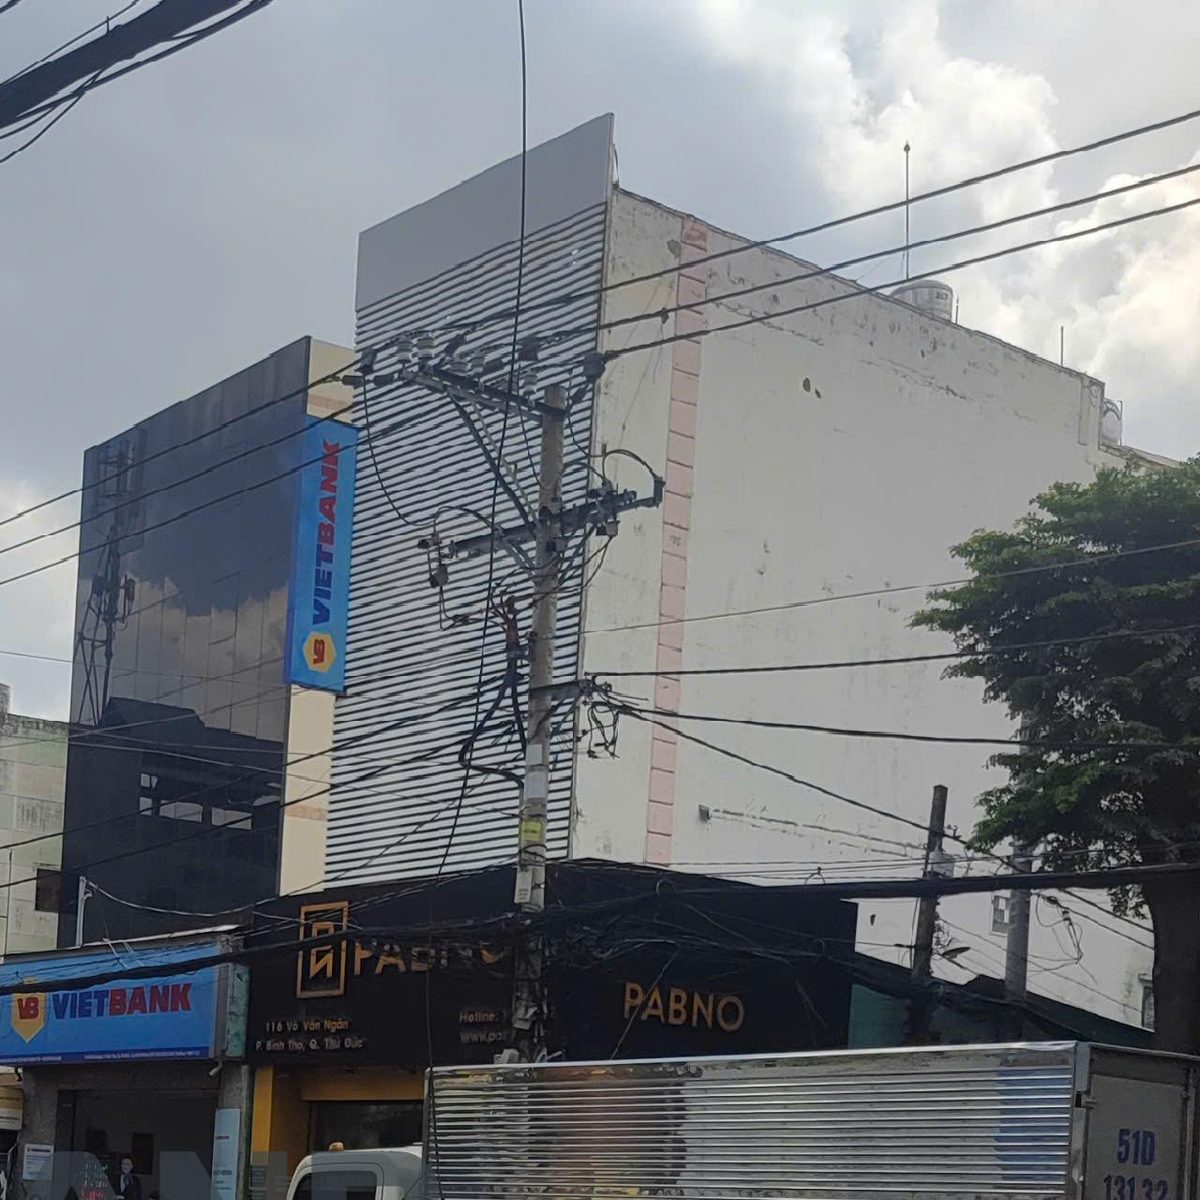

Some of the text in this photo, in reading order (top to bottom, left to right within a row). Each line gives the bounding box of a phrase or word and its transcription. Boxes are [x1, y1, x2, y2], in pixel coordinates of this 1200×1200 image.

[312, 438, 341, 625] VIETBANK
[53, 982, 193, 1020] VIETBANK
[623, 981, 745, 1033] PABNO
[265, 1021, 284, 1033] 116
[1117, 1128, 1156, 1166] 51D
